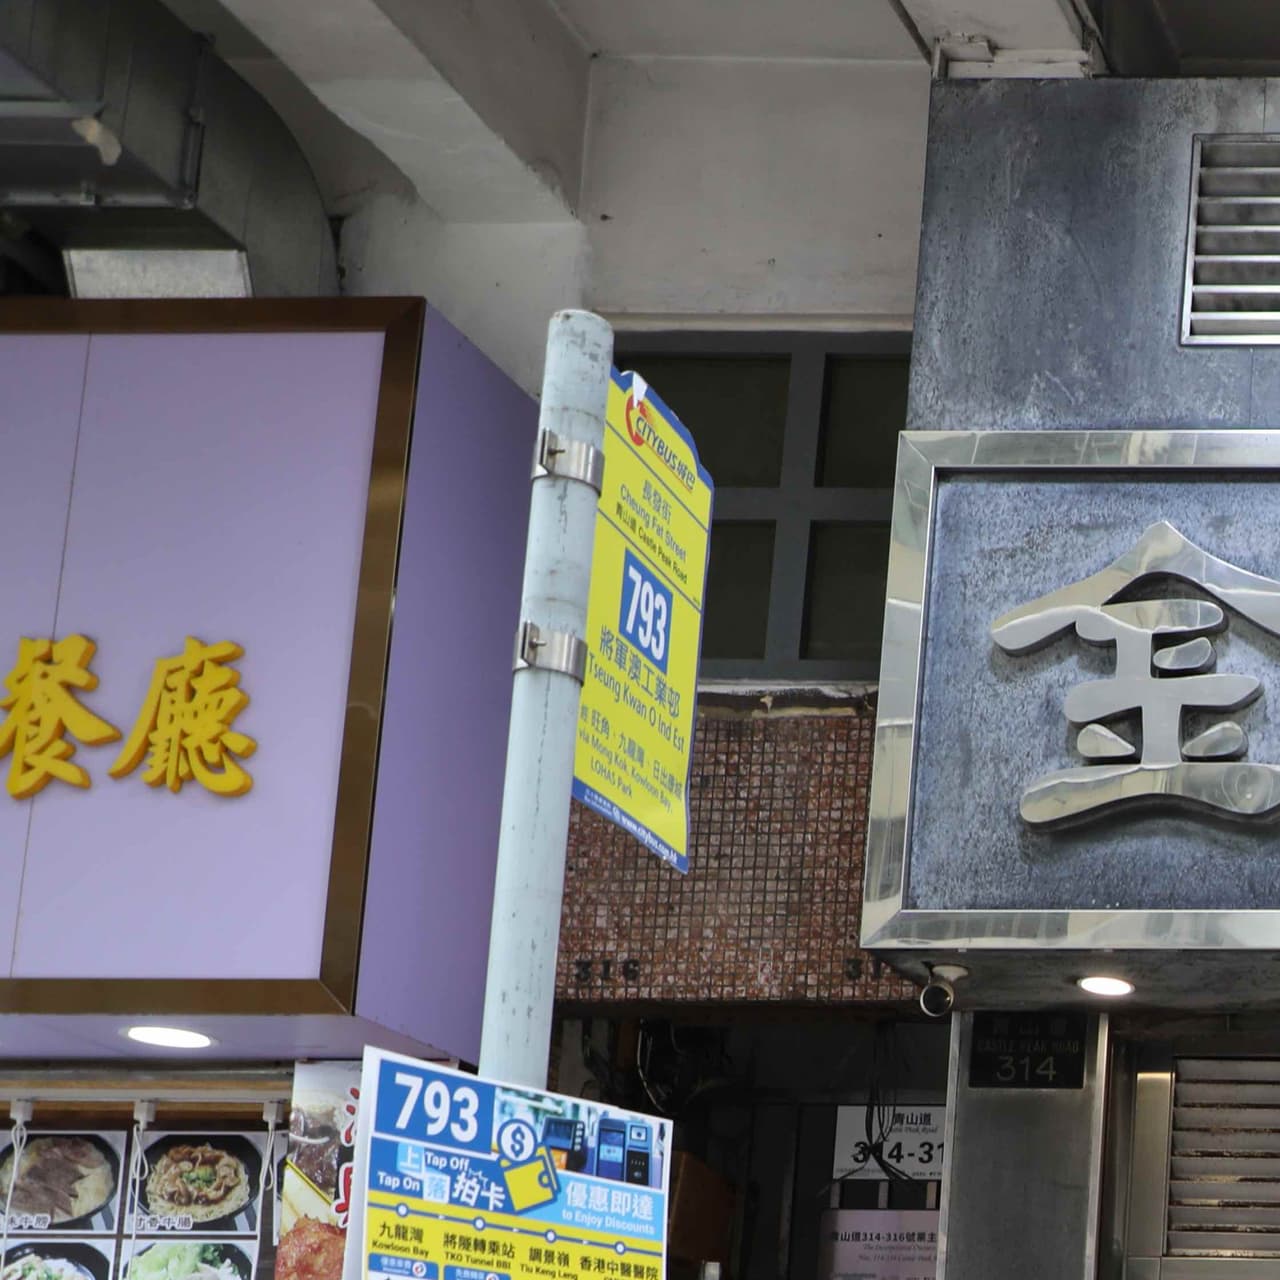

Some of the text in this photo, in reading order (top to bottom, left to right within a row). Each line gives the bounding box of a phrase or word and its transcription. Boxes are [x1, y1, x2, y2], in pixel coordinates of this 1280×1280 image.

[634, 416, 678, 471] CITYBUS
[620, 484, 687, 563] Cheung Fat Street
[642, 480, 671, 524] 長發街
[638, 527, 656, 553] Castle
[658, 548, 671, 568] Peak
[673, 562, 687, 584] Road
[627, 565, 668, 661] 793
[600, 625, 681, 718] 將軍澳工業邨
[0, 632, 257, 800] 餐廳
[588, 652, 620, 703] Tseung
[623, 684, 647, 719] Kwan
[658, 714, 671, 741] Ind
[673, 731, 685, 755] Est
[590, 756, 633, 798] LOHAS Park
[995, 1055, 1057, 1082] 314
[393, 1071, 480, 1143] 793
[401, 1144, 469, 1173] 上 Tap Off
[377, 1171, 400, 1191] Tap
[402, 1175, 420, 1193] On
[451, 1171, 507, 1213] 拍卡
[565, 1181, 655, 1221] 優惠即達
[378, 1222, 424, 1245] 九龍灣
[528, 1246, 571, 1269] 調景嶺
[574, 1210, 602, 1229] Enjoy
[604, 1215, 656, 1236] Discounts
[371, 1239, 411, 1256] Kowloon
[412, 1245, 430, 1259] Bay
[445, 1251, 464, 1264] TKO
[465, 1254, 493, 1268] Tunnel
